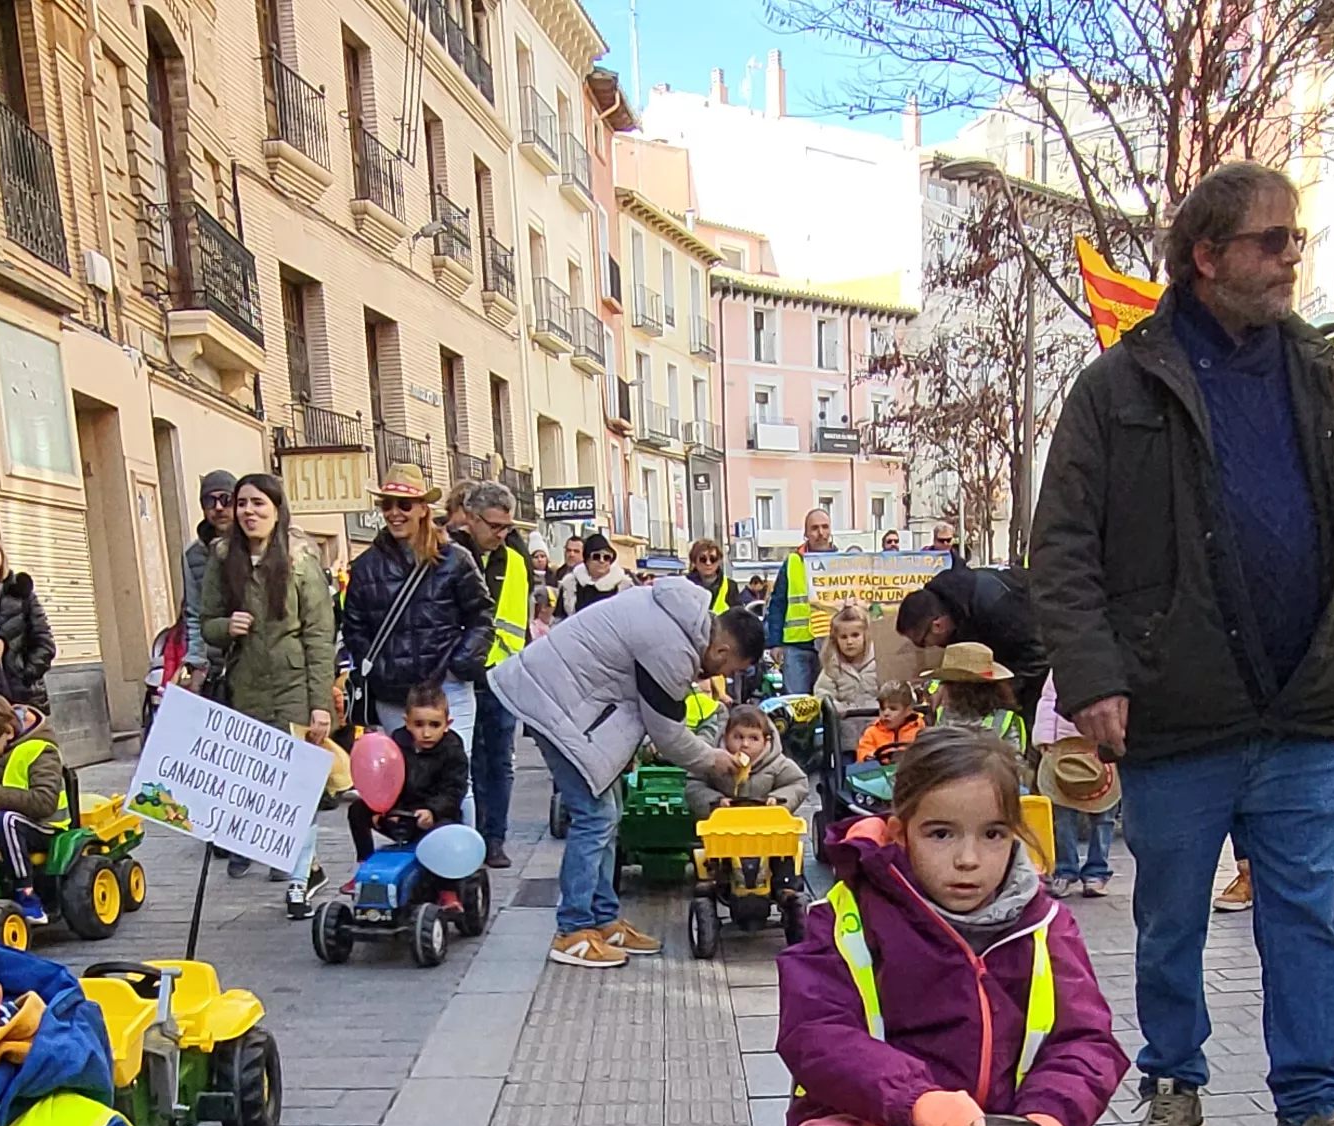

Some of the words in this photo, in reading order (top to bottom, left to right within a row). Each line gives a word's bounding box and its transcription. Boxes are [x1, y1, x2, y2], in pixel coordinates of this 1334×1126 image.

[545, 496, 594, 512] Arenas
[811, 561, 826, 571] LA
[812, 576, 825, 587] ES
[828, 575, 856, 587] MUY
[892, 574, 934, 586] CUAND
[859, 590, 883, 601] CON
[887, 589, 904, 601] UN
[204, 706, 223, 732] YO
[224, 715, 272, 752] QUIERO
[271, 736, 294, 762] SER
[189, 736, 277, 788] AGRICULTORA
[278, 770, 289, 792] Y
[158, 755, 227, 800] GANADERA
[228, 783, 265, 815] COMO
[266, 798, 302, 828] PAPÁ
[226, 814, 249, 842] ME
[250, 823, 296, 859] DEJAN
